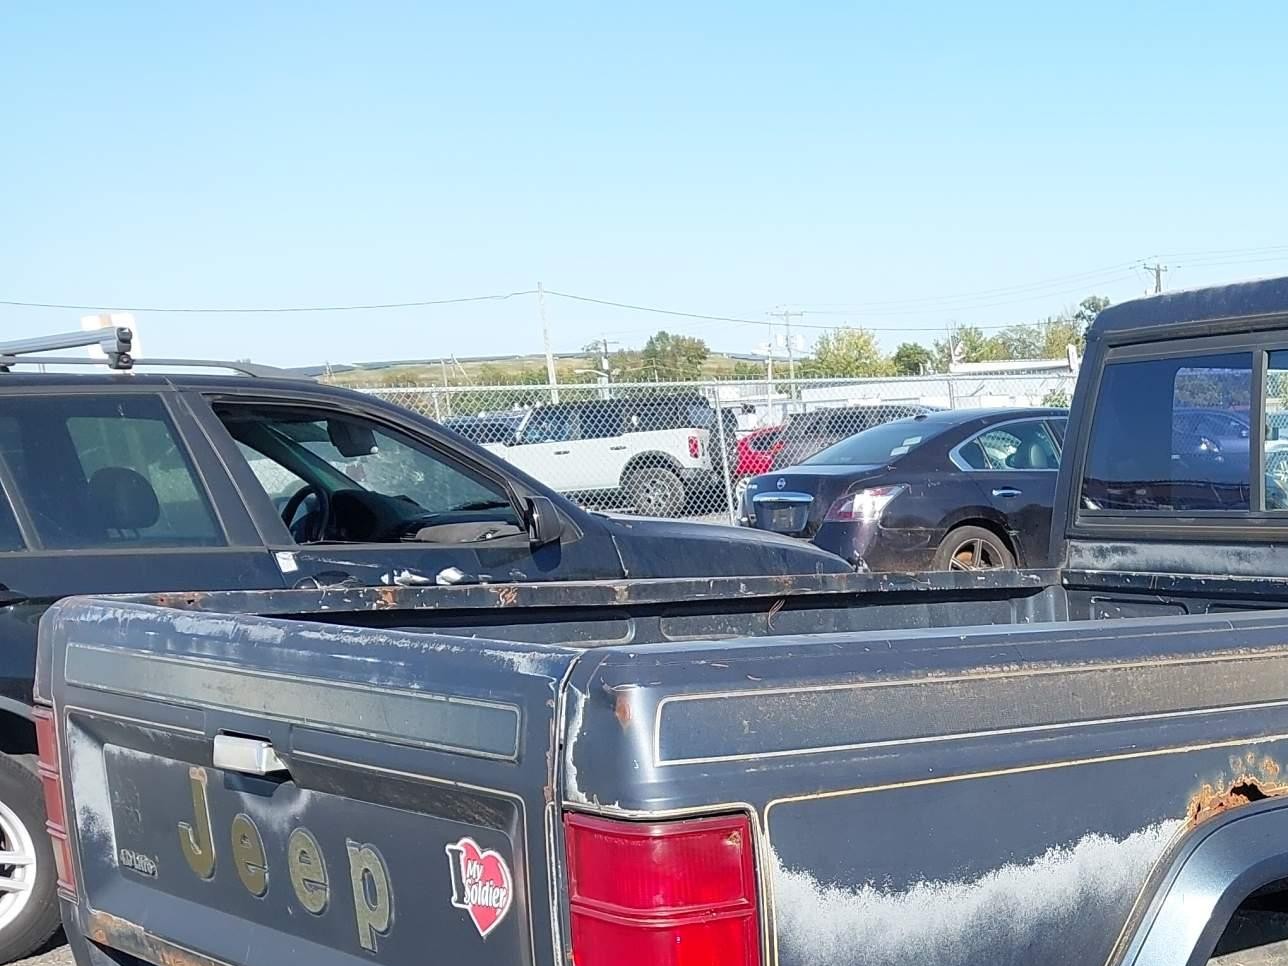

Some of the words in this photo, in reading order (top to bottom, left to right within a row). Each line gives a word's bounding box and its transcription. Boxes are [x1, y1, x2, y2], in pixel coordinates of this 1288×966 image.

[177, 766, 395, 954] Jeep
[466, 859, 484, 883] My
[463, 879, 507, 909] Soldier
